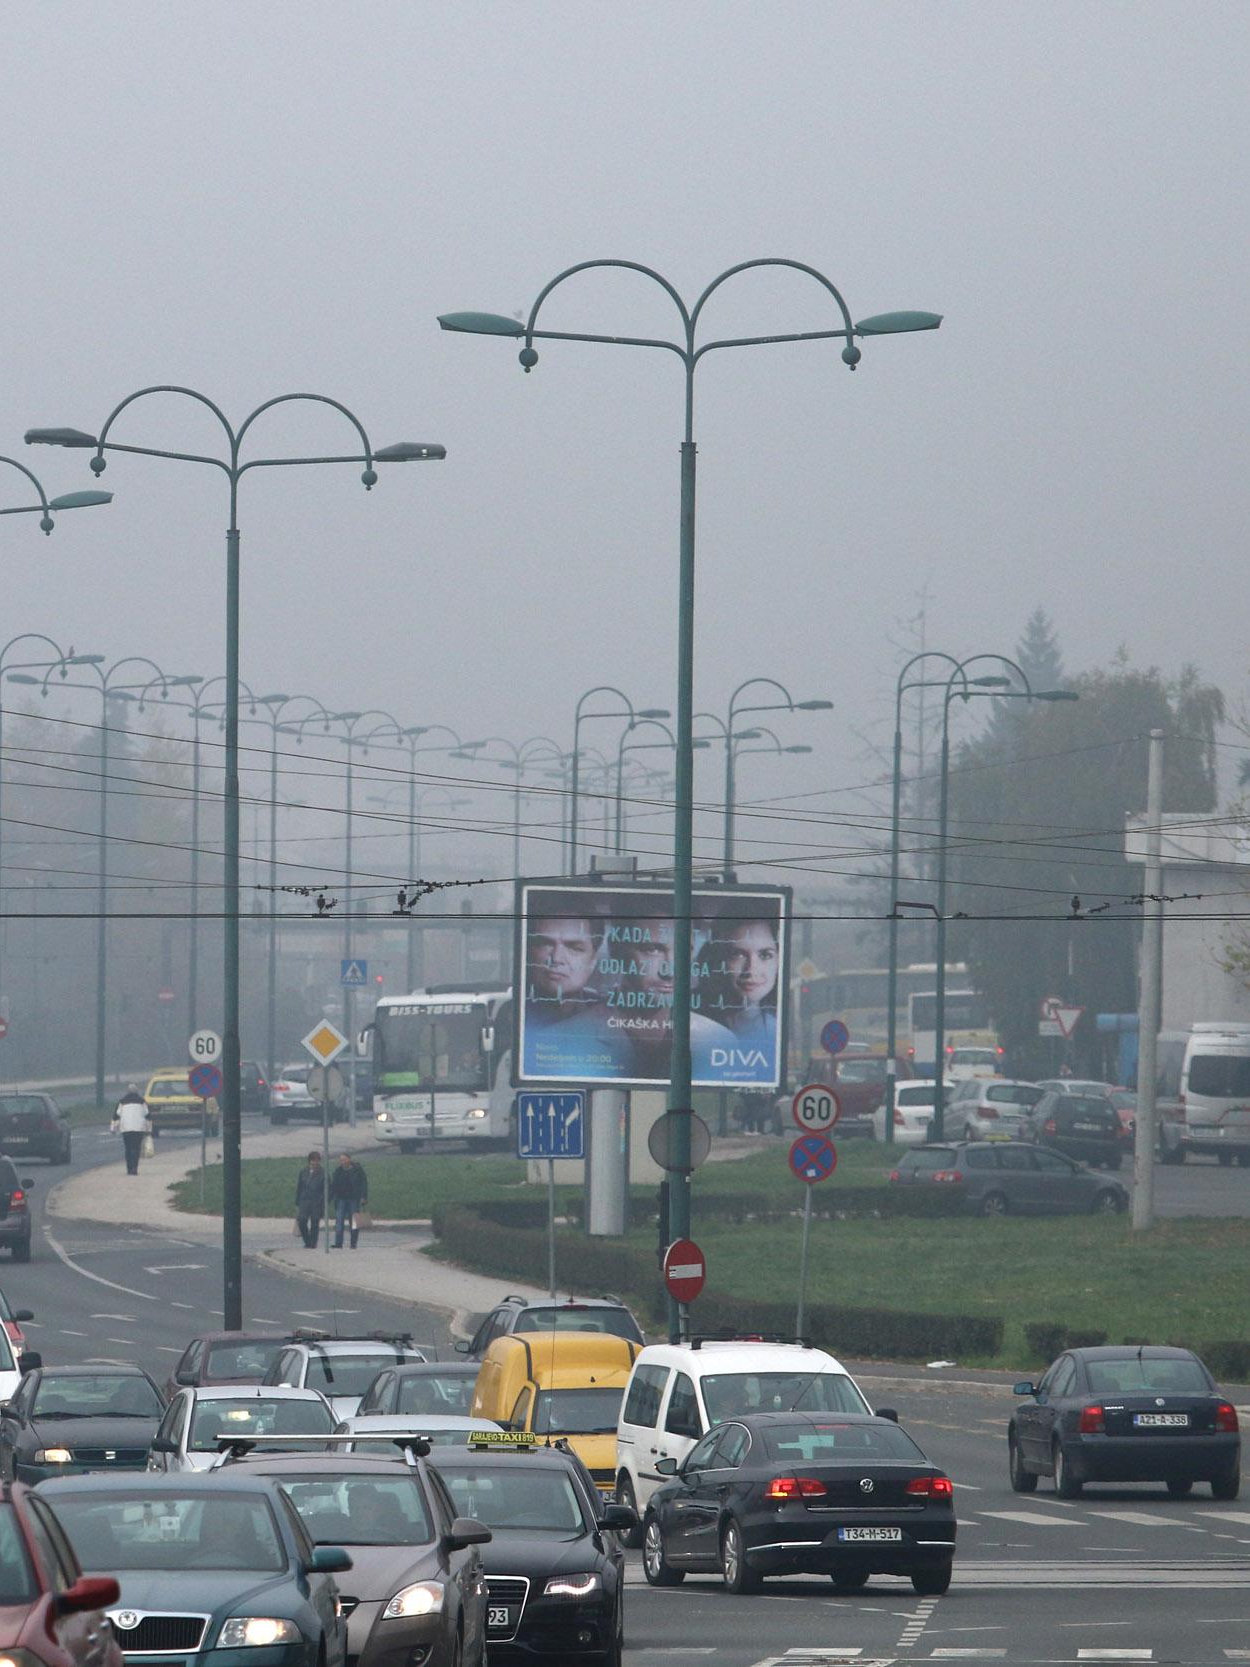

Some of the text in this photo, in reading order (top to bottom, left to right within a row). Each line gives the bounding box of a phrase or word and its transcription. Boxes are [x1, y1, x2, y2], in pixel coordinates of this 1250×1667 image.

[610, 927, 652, 943] KADA
[607, 1016, 659, 1029] ČIKAŠKA
[196, 1037, 215, 1055] 60
[711, 1048, 768, 1067] DIVA
[803, 1096, 830, 1121] 60
[1138, 1415, 1188, 1425] A21-A-338
[845, 1529, 900, 1540] T34-M-517
